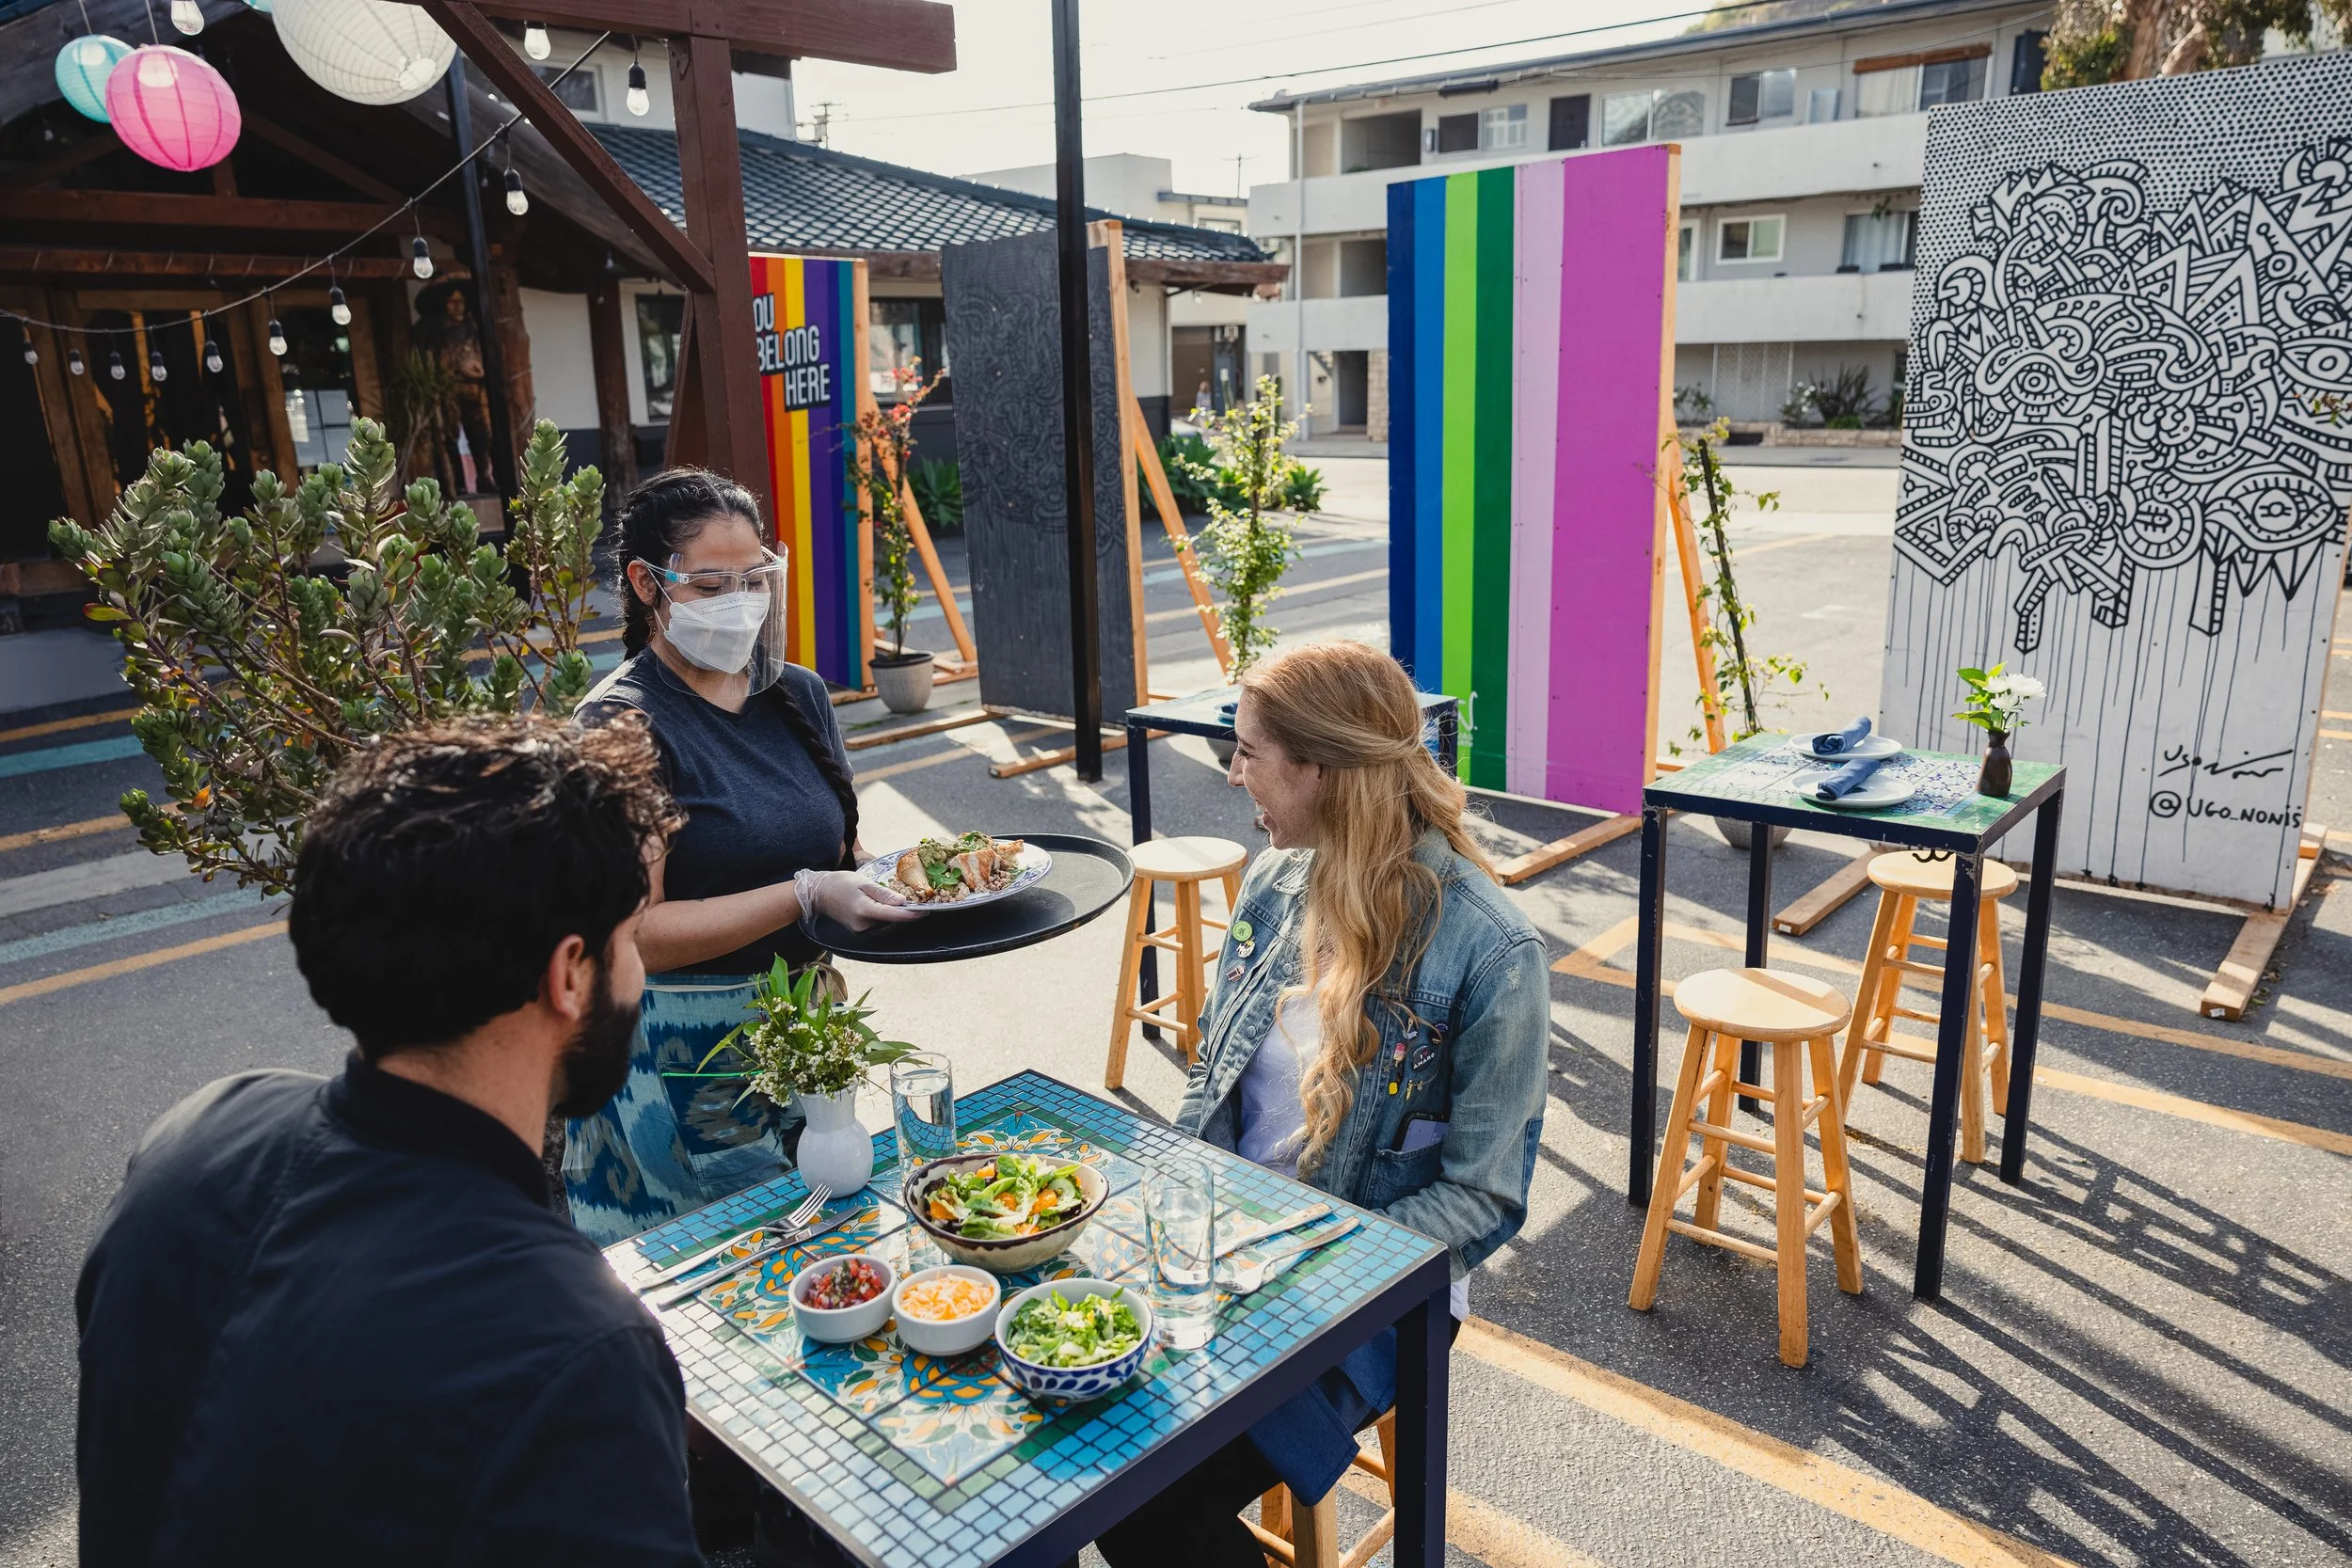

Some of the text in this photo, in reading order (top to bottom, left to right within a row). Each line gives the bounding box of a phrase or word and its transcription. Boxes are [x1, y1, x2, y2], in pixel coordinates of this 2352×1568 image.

[753, 293, 775, 333] OU
[756, 325, 820, 372] BELONG
[784, 363, 831, 407] HERE
